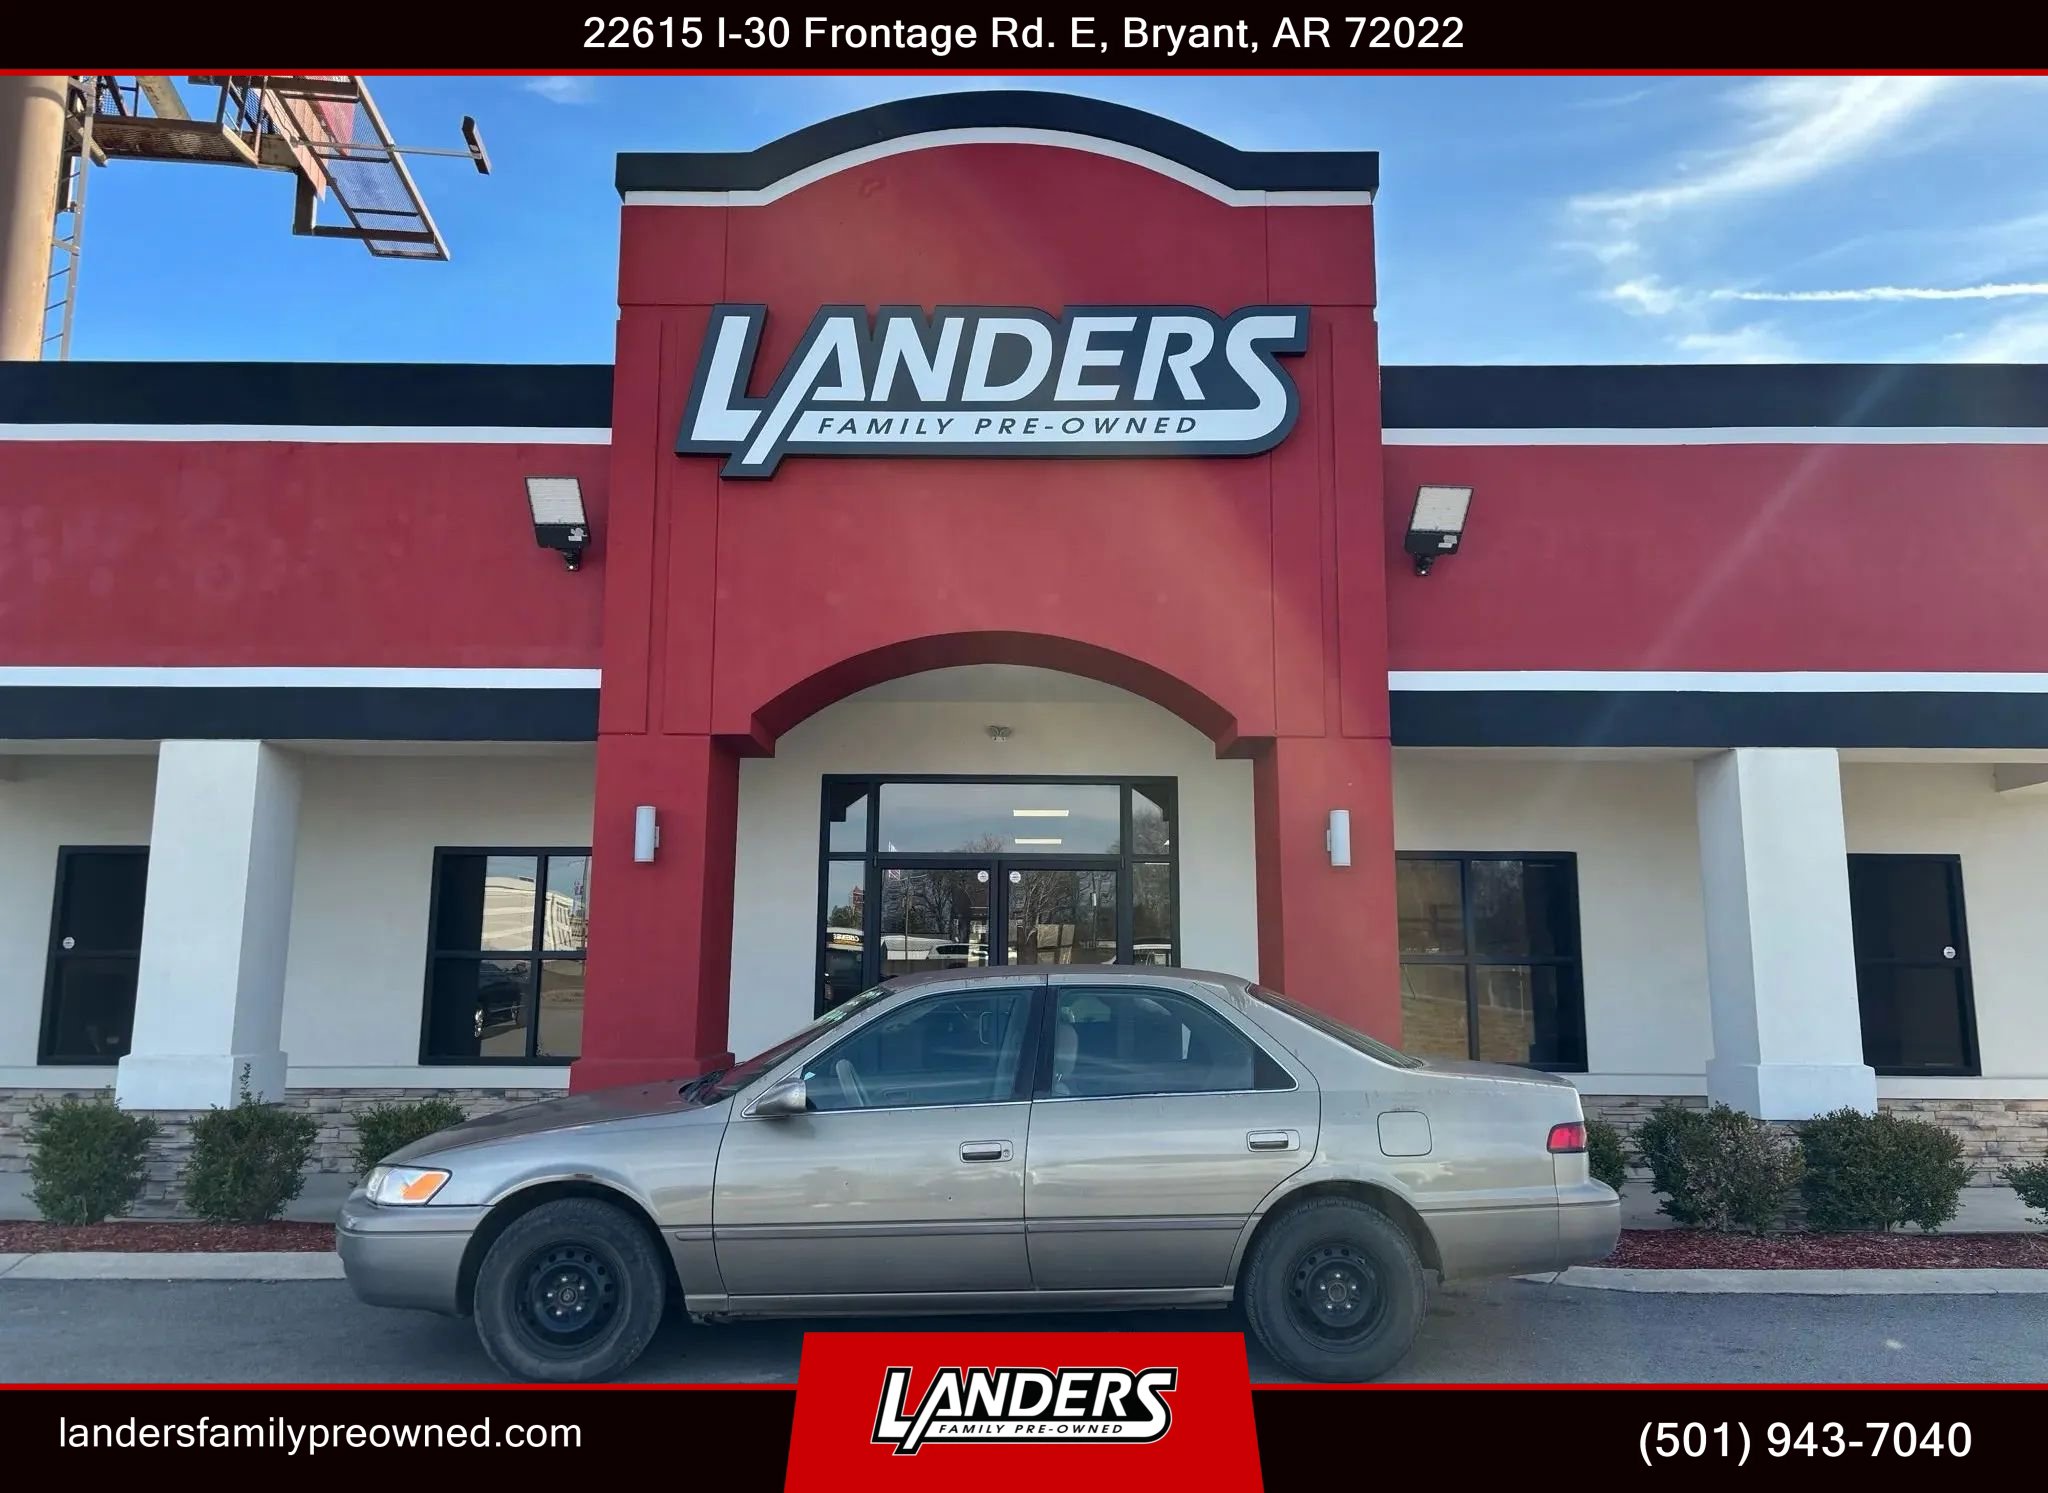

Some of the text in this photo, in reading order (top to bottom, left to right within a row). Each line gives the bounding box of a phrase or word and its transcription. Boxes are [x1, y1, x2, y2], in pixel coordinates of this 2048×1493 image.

[690, 315, 1297, 465] LANDERS
[817, 416, 1199, 436] FAMILY PRE-OWNED
